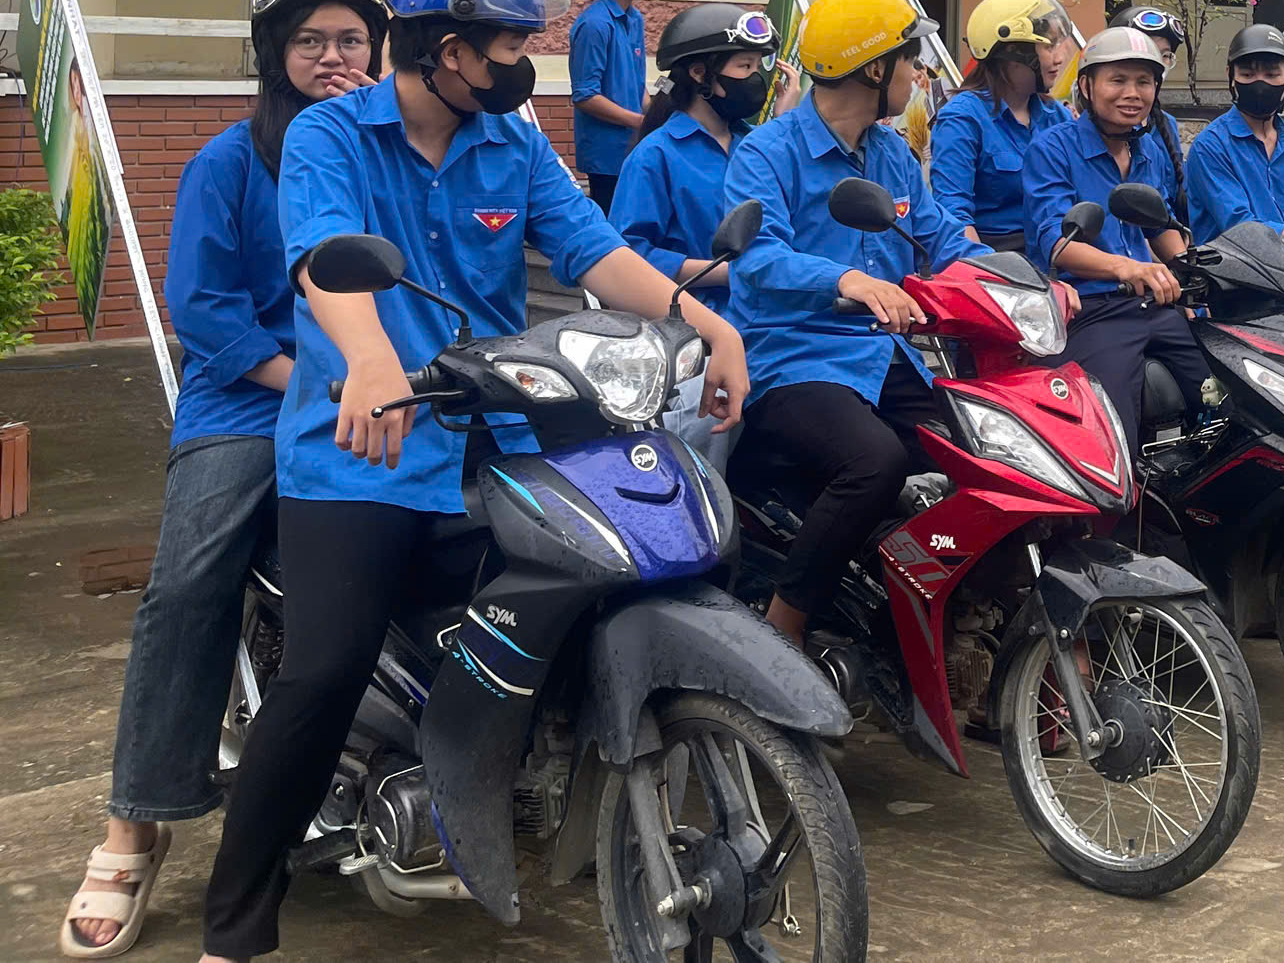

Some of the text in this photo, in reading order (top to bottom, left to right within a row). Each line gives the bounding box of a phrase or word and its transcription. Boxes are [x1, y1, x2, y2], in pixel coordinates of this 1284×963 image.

[841, 31, 887, 59] FEEL GOOD
[930, 533, 956, 551] SYM
[486, 604, 517, 627] SYM
